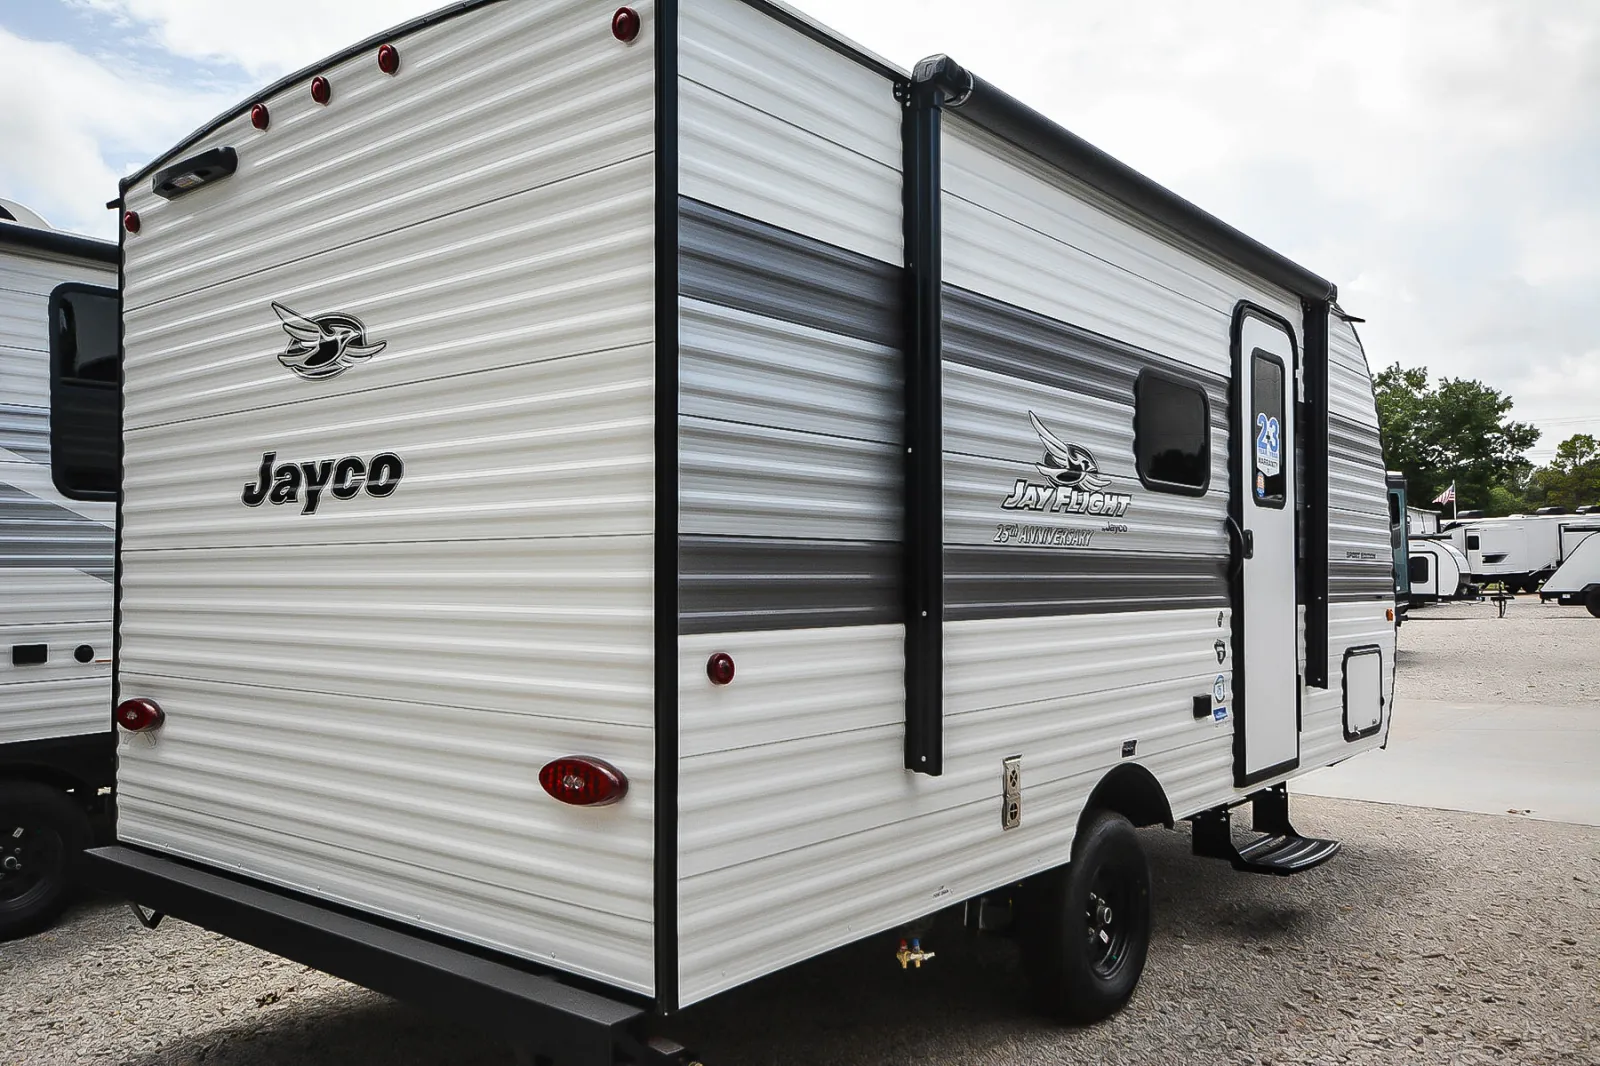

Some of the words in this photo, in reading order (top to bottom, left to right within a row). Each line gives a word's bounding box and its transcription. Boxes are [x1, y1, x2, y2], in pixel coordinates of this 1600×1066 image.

[241, 452, 404, 515] Jayco
[1001, 479, 1054, 511] JAY
[1051, 486, 1132, 517] FLIGHT
[993, 524, 1020, 543] 25th
[1018, 525, 1095, 547] ANNIVERSARY
[1105, 521, 1128, 535] Jayco
